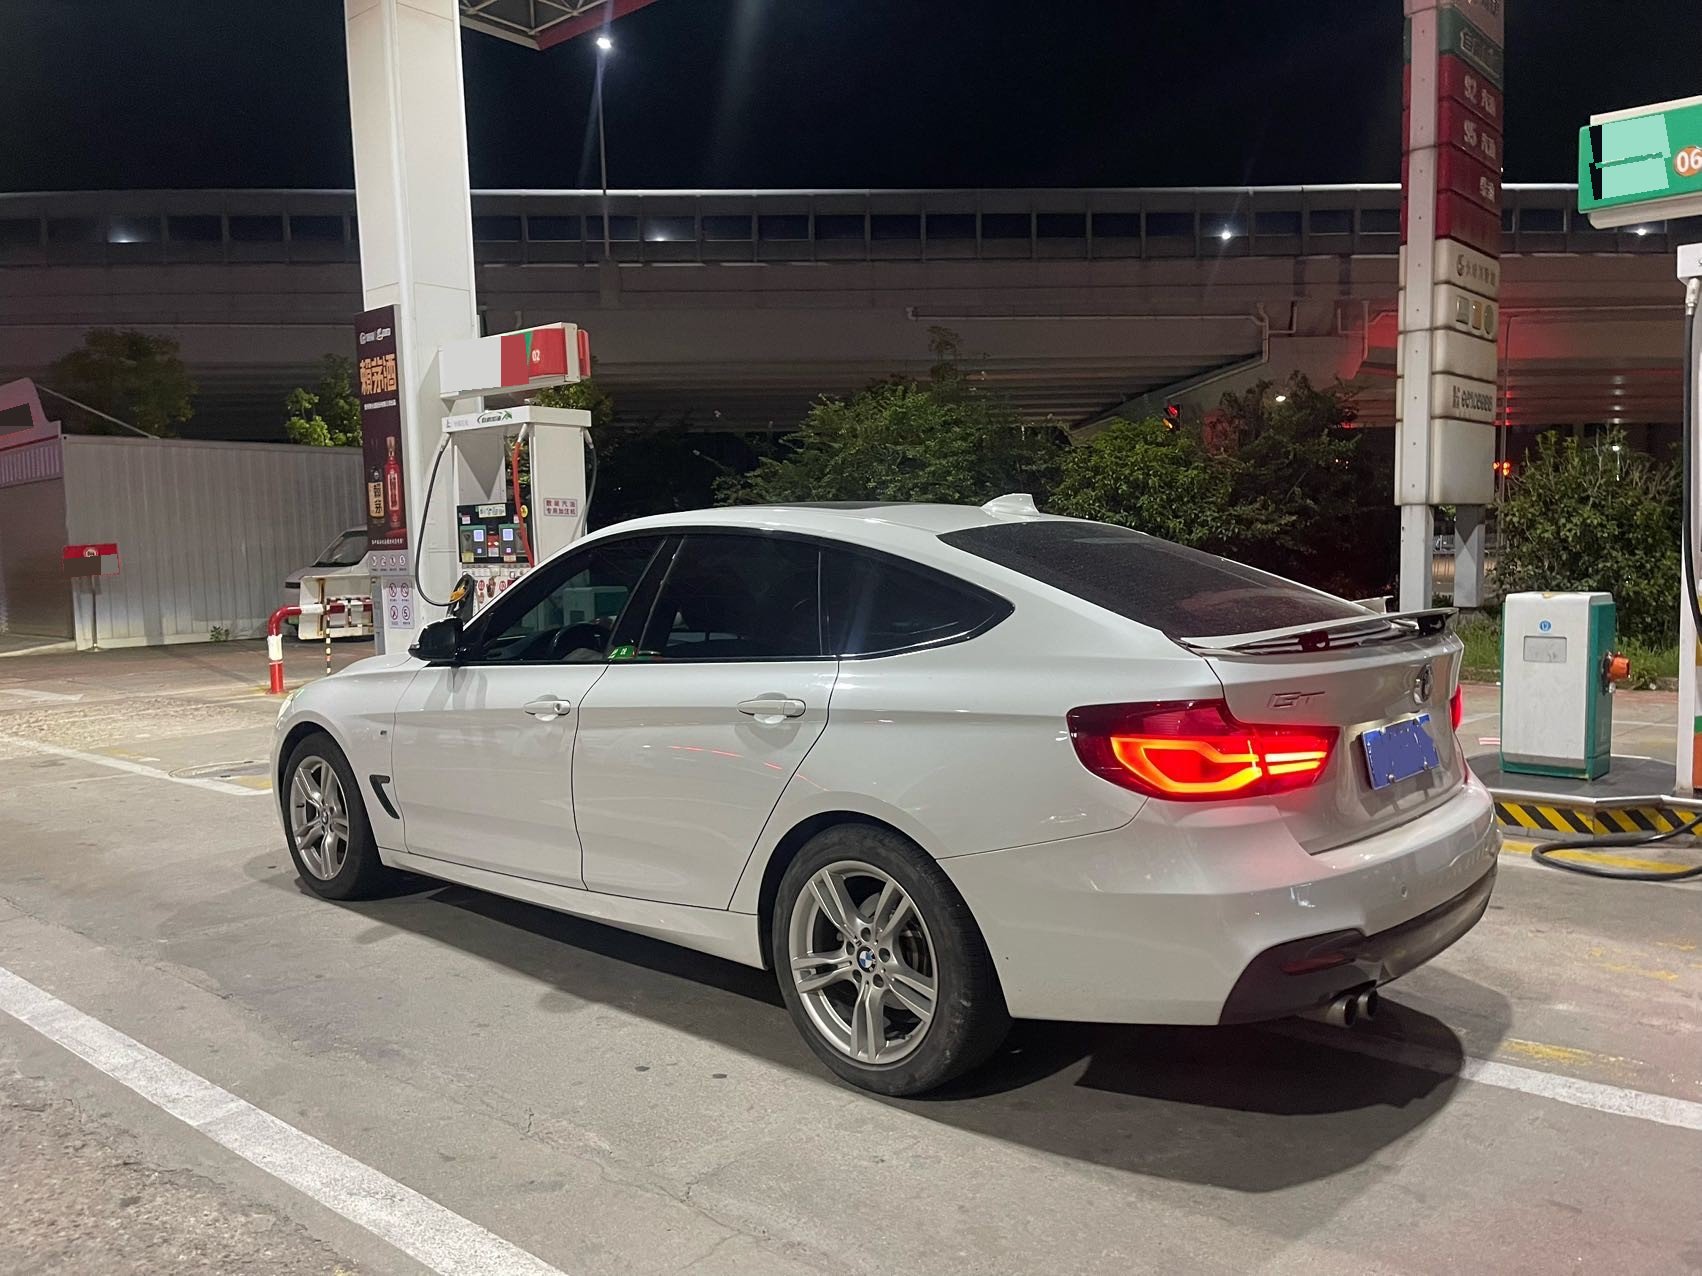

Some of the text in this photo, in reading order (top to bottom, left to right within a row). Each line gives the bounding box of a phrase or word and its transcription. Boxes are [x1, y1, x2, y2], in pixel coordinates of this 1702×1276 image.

[1676, 148, 1702, 173] 06
[531, 349, 541, 362] 02
[1267, 690, 1326, 709] GT
